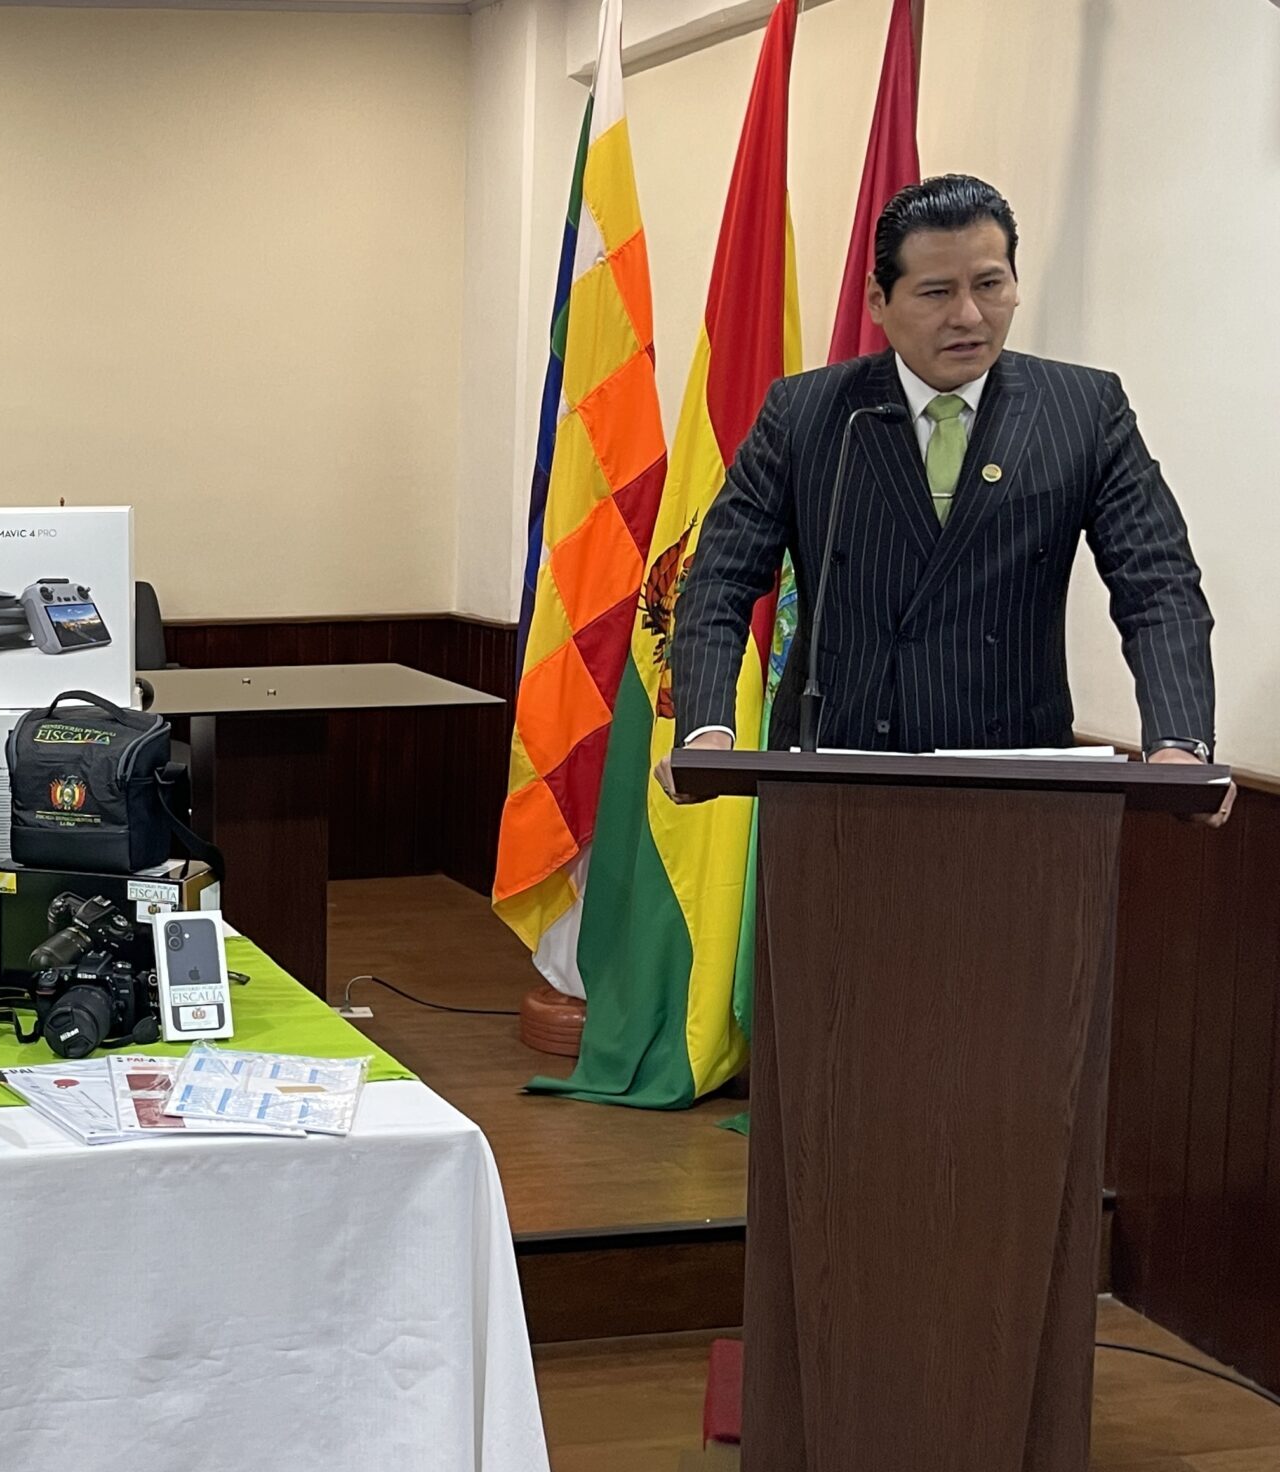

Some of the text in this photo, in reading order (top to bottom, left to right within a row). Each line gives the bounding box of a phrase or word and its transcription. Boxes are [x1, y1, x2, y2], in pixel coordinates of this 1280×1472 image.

[29, 529, 36, 537] 4
[38, 528, 58, 538] PRO
[35, 728, 110, 744] FISCALÍA
[129, 886, 177, 901] FISCALÍA
[76, 972, 97, 980] Nikon
[172, 989, 225, 1002] FISCALÍA
[59, 1027, 80, 1042] Nikon
